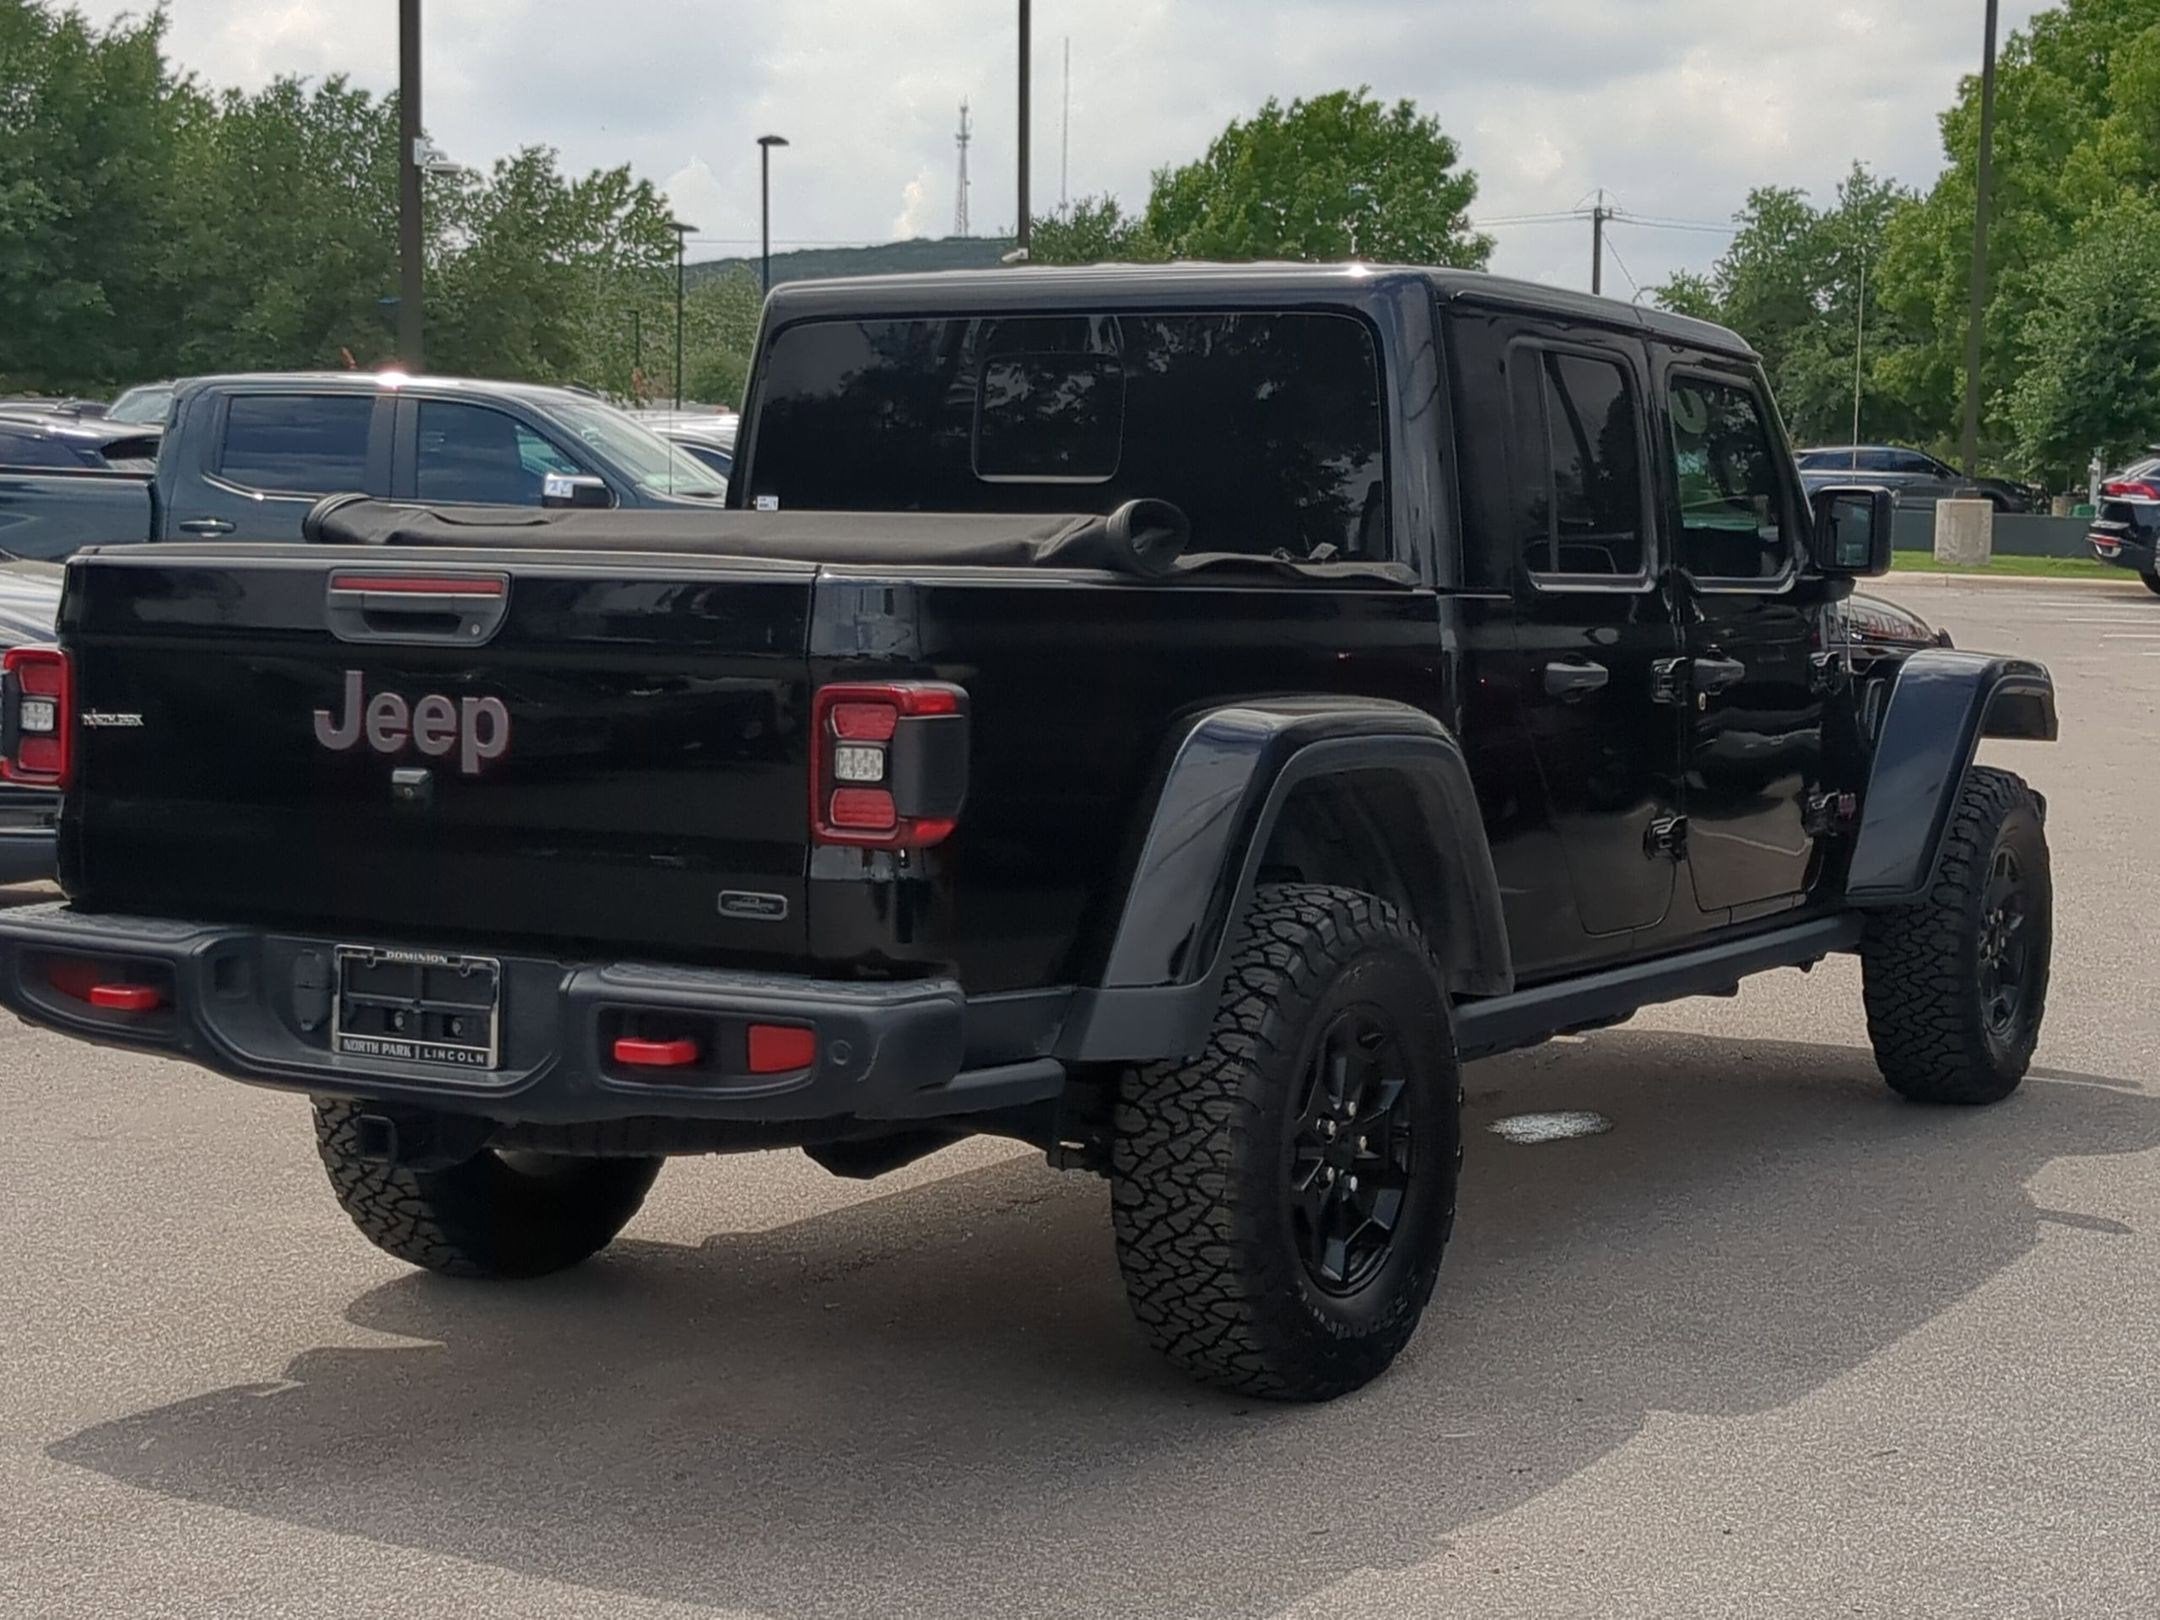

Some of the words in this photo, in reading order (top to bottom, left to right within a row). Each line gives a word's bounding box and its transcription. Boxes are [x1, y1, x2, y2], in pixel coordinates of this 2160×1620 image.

[313, 670, 509, 774] Jeep
[386, 950, 448, 964] DOMINION
[343, 1039, 379, 1054] NORTH
[382, 1043, 411, 1057] PARK
[424, 1048, 485, 1064] LINCOLN
